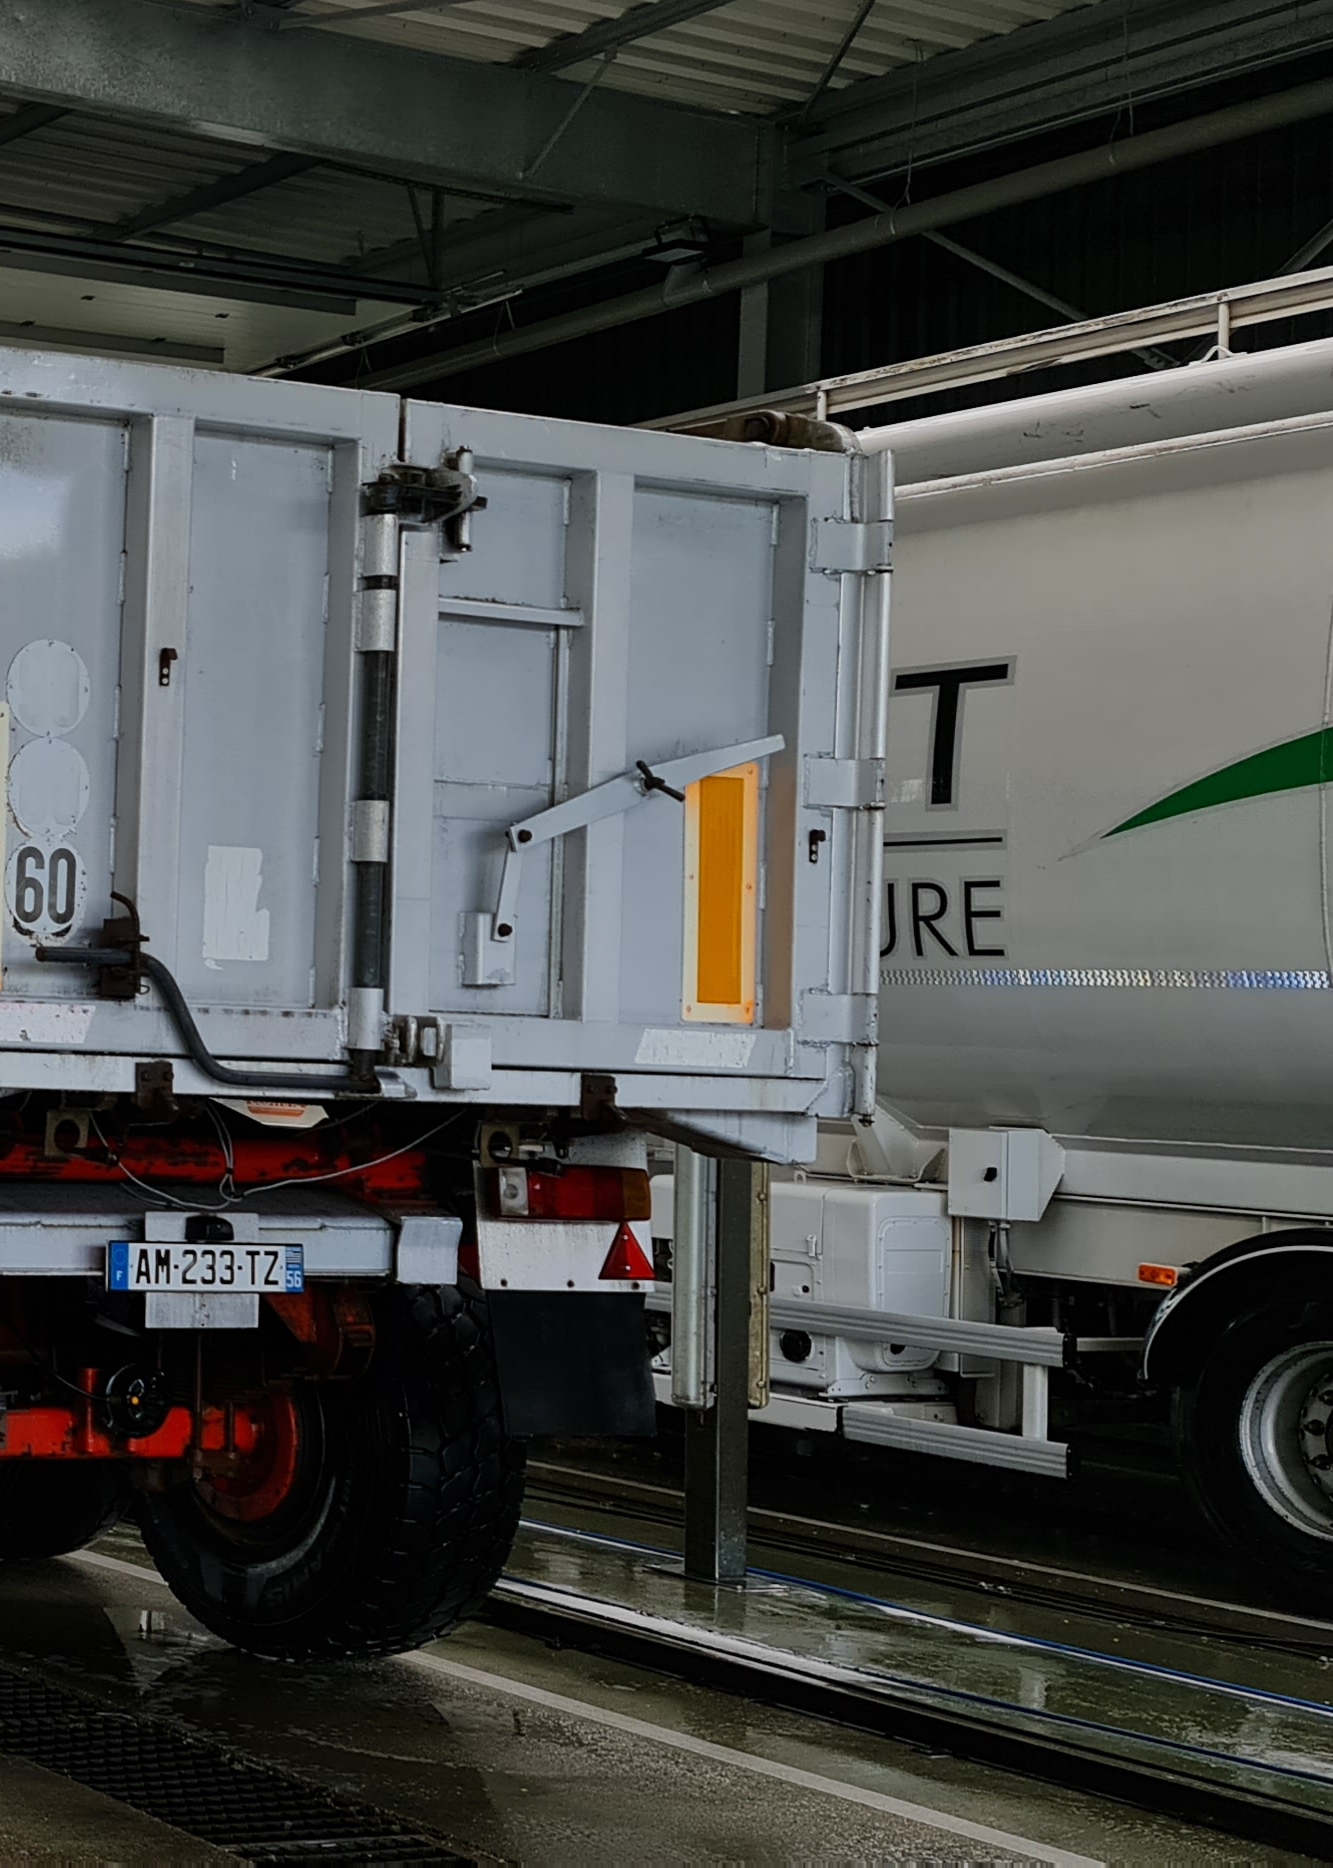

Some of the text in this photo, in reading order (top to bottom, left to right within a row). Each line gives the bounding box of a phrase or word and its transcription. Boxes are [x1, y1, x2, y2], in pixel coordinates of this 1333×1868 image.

[15, 845, 77, 925] 60
[135, 1248, 280, 1285] AM-233-TZ
[286, 1270, 302, 1288] 56
